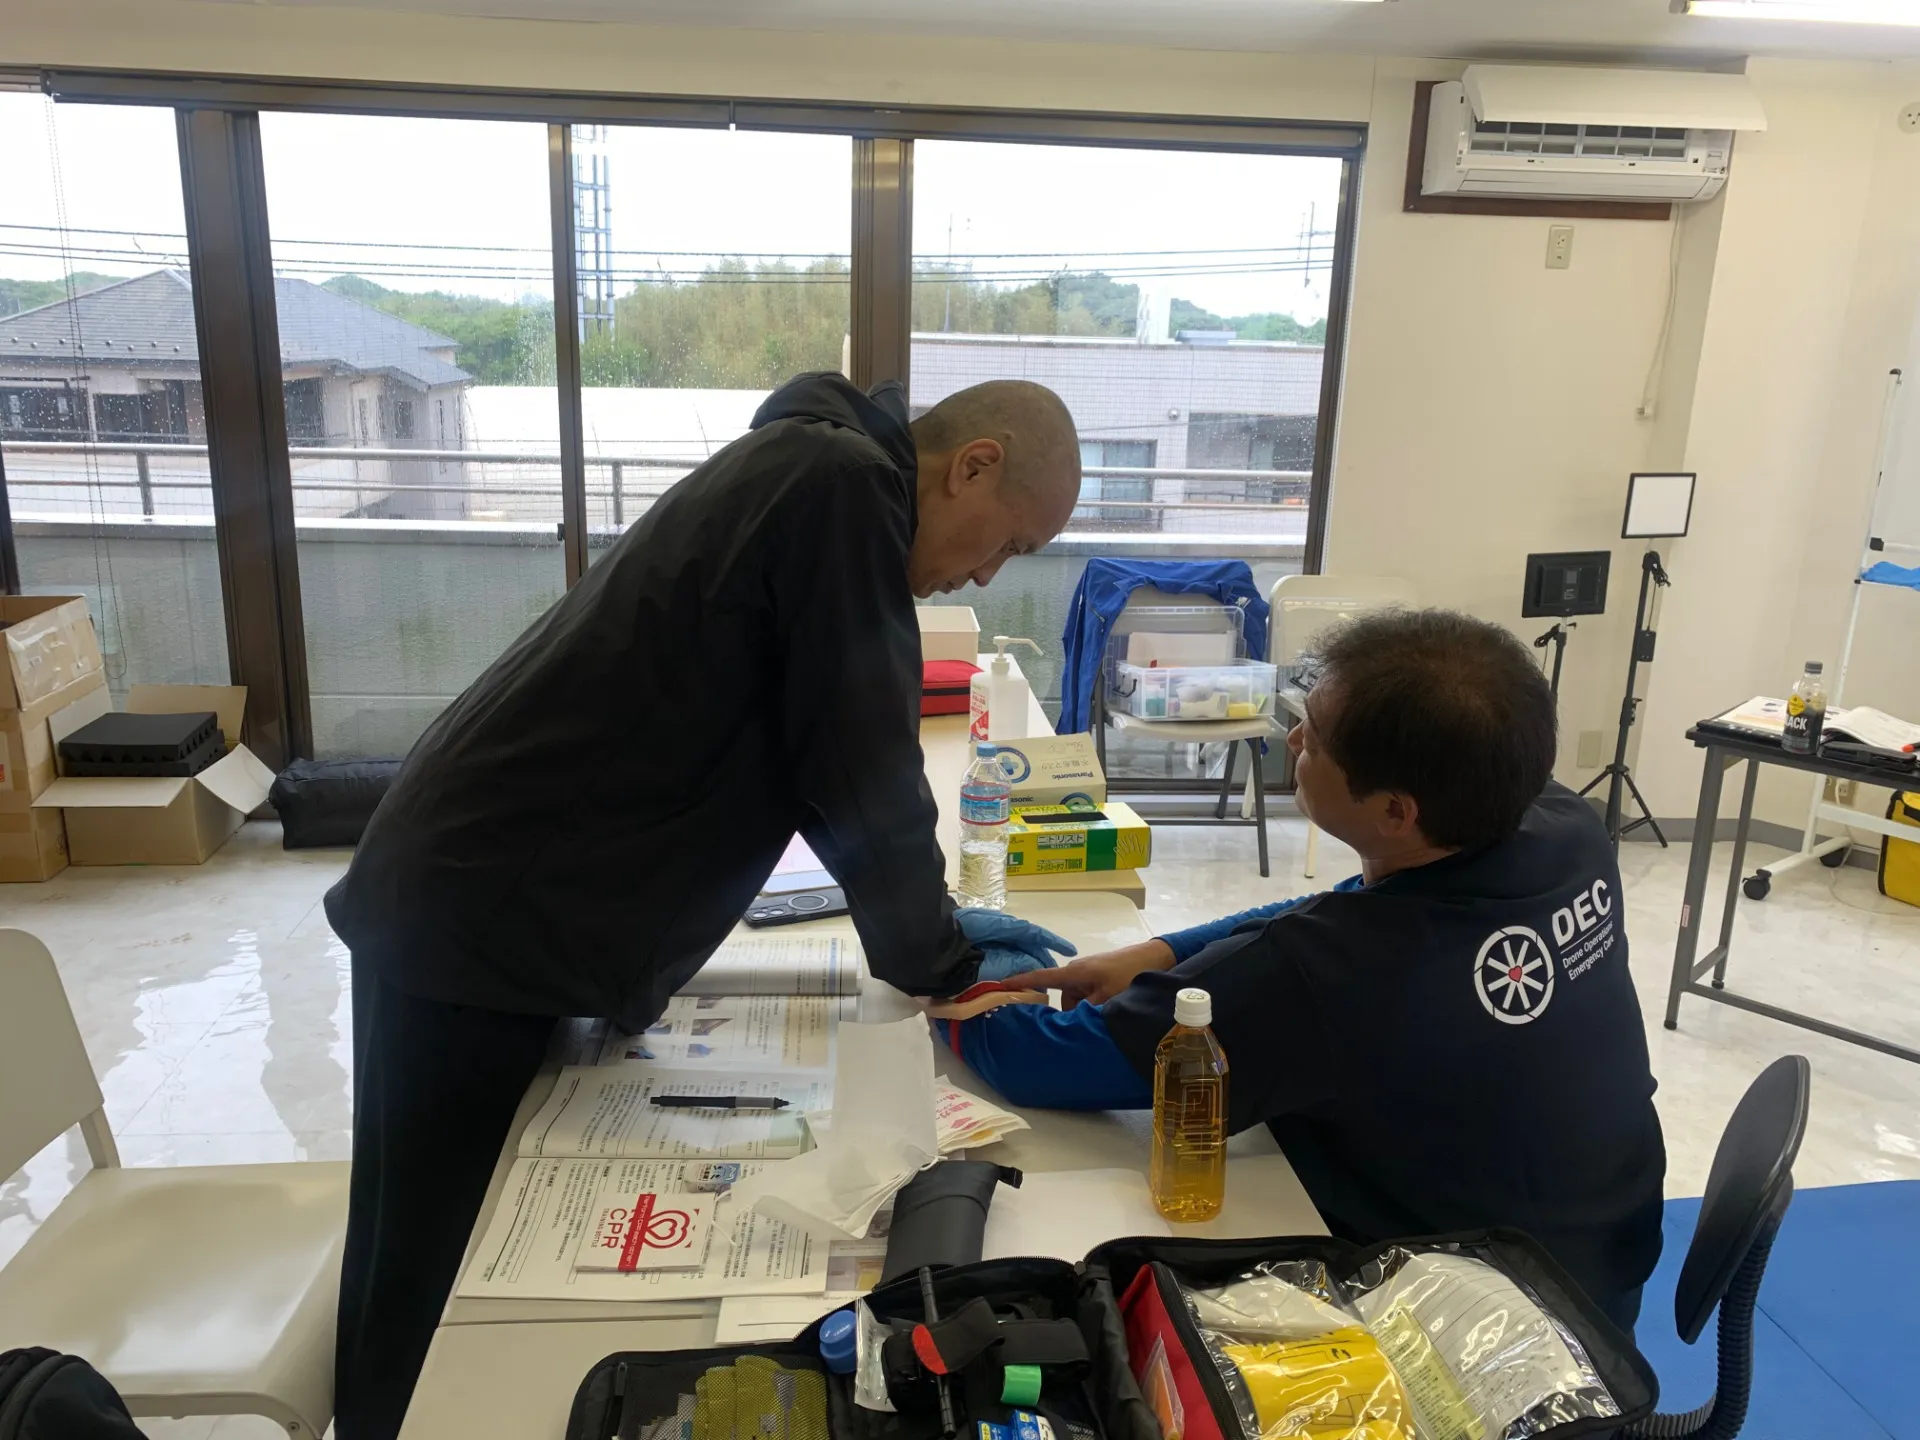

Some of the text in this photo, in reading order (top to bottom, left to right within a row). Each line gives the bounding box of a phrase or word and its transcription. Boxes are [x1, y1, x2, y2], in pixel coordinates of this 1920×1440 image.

[1052, 771, 1094, 780] Panasonic
[1038, 834, 1083, 844] ニトリスト
[1552, 879, 1612, 947] DEC
[1562, 948, 1584, 969] Drone
[1568, 946, 1604, 981] Emergency
[591, 1208, 610, 1248] TRAINING BOTTLE
[601, 1208, 628, 1249] CPR
